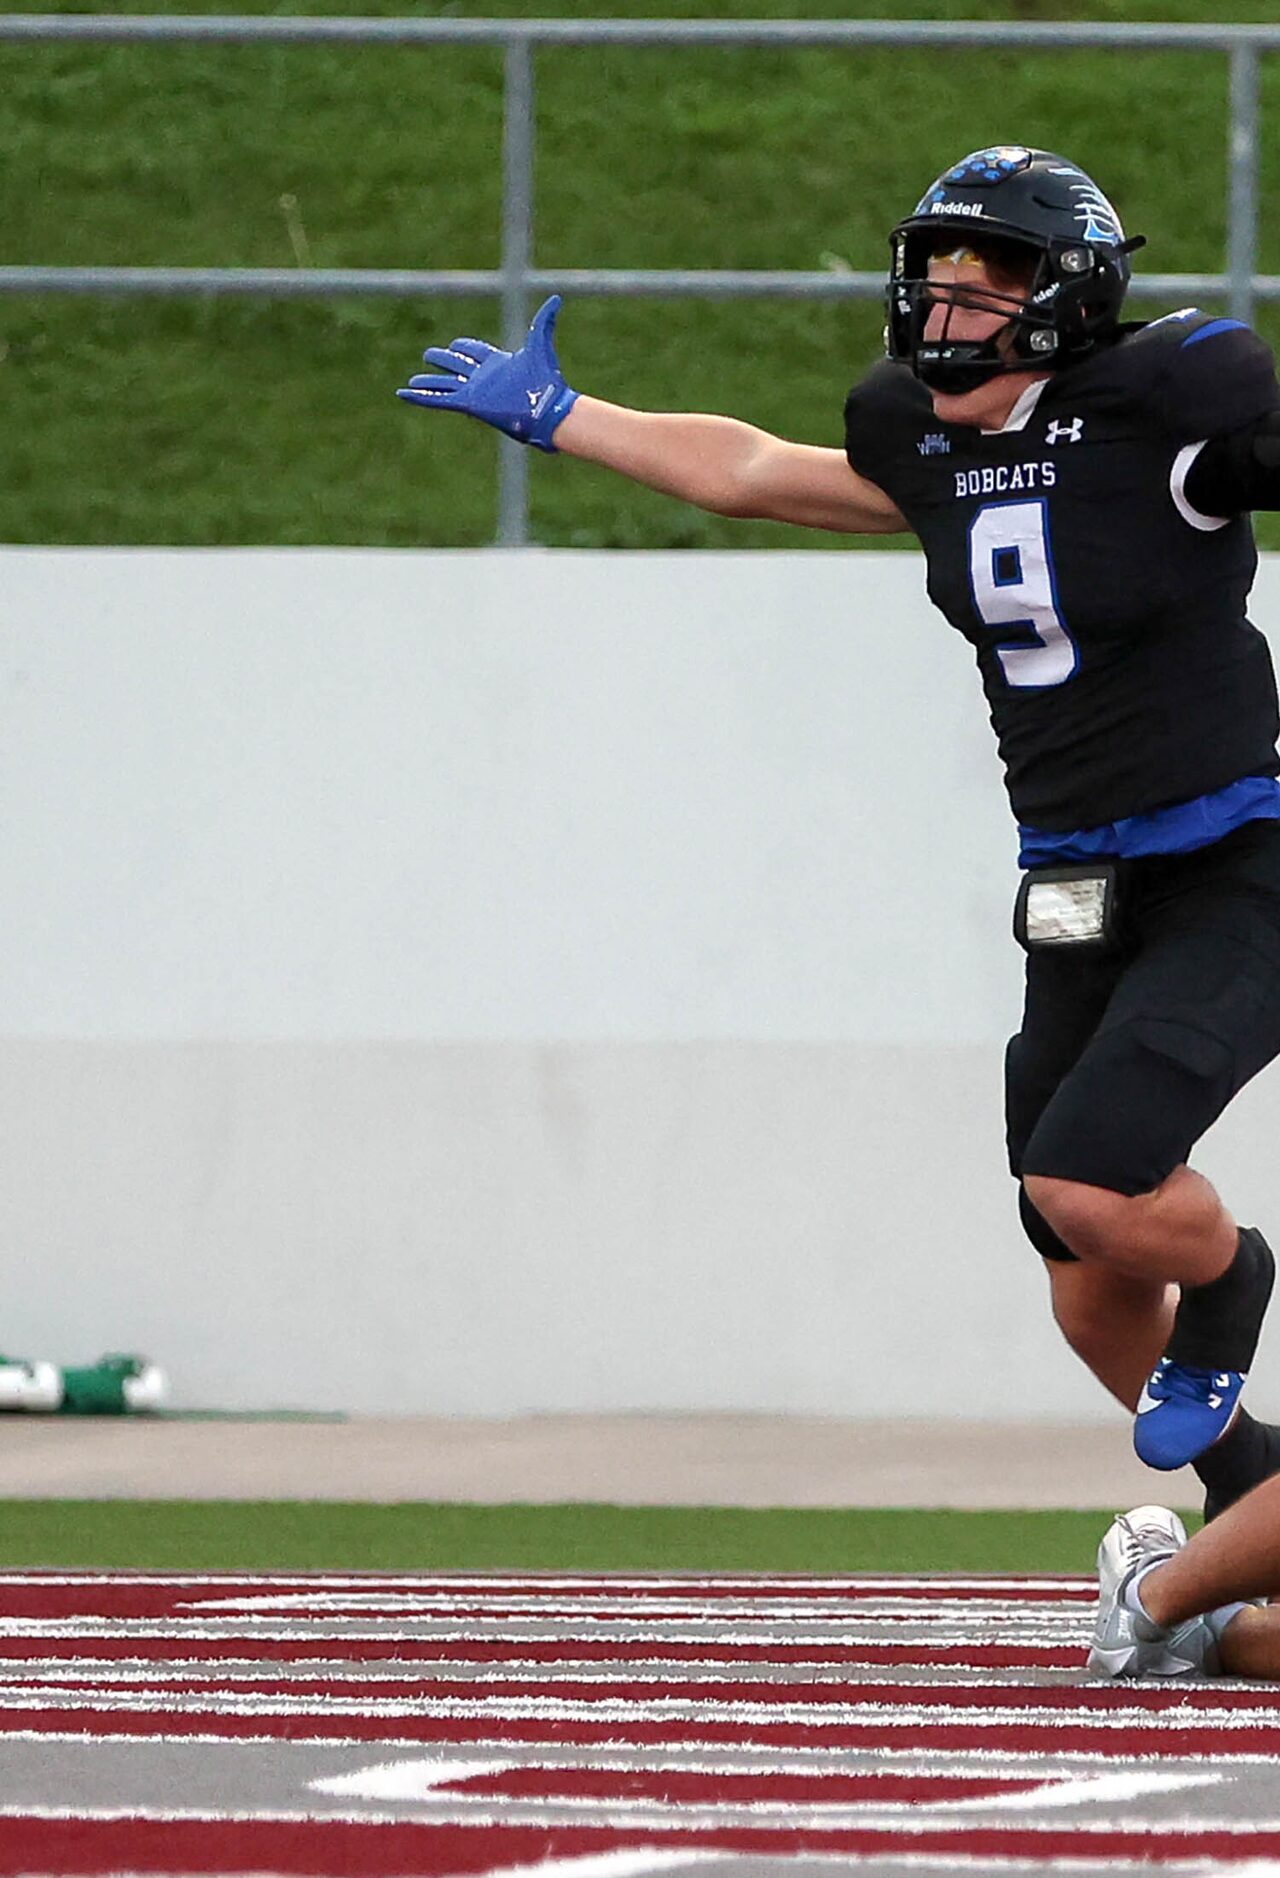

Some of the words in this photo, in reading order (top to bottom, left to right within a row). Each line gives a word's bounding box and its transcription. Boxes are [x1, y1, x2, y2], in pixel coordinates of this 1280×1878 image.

[930, 201, 983, 216] Riddell
[954, 461, 1056, 498] BOBCATS
[968, 498, 1080, 690] 9
